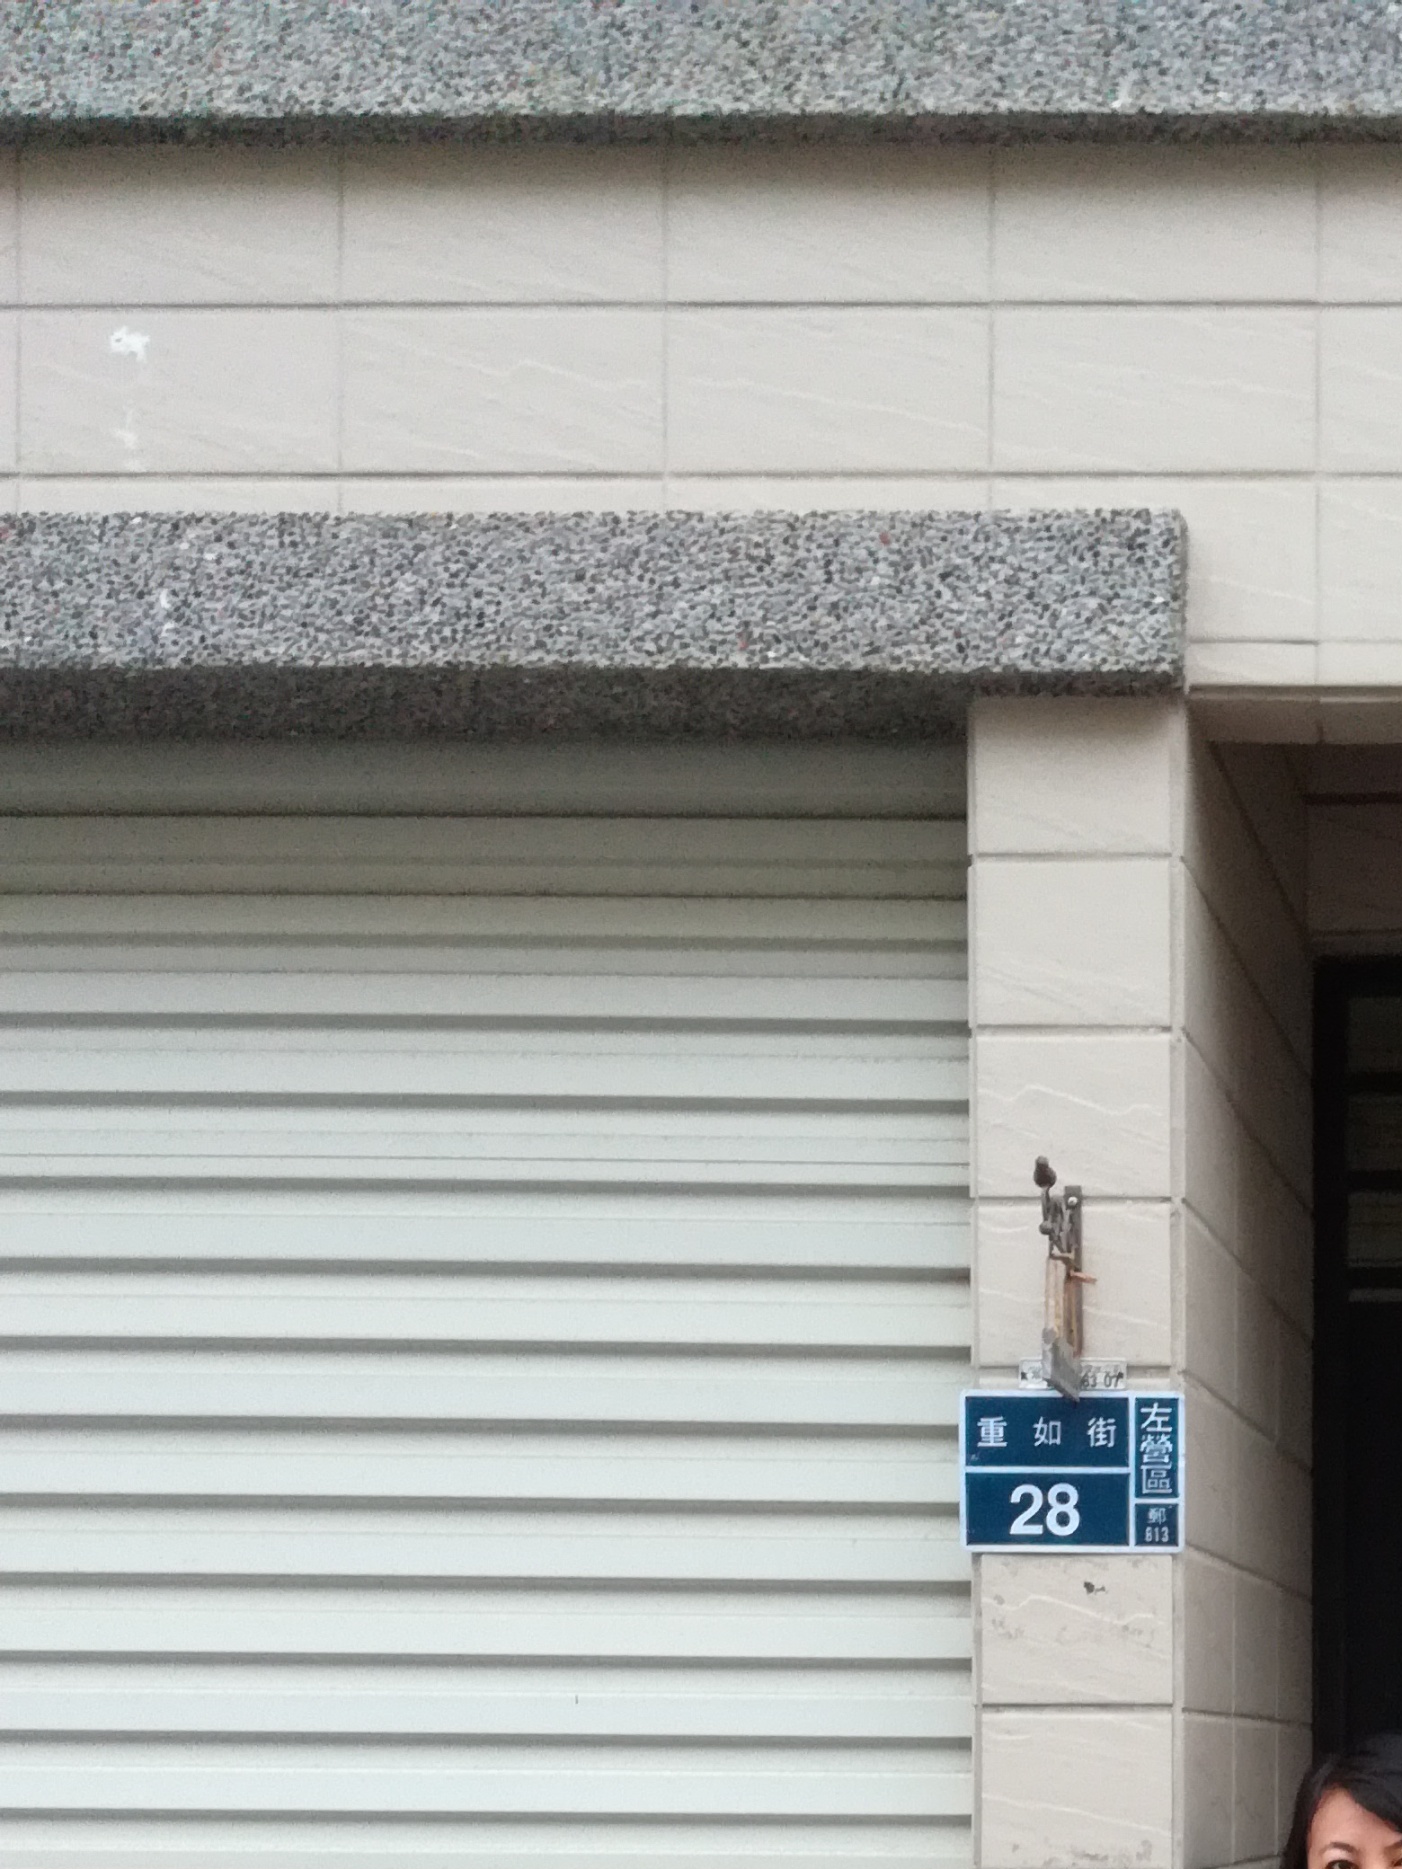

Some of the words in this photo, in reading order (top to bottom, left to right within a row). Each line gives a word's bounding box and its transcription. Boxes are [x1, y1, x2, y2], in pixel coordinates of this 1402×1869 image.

[976, 1416, 1117, 1448] 重如街
[1139, 1402, 1173, 1494] 左營區
[1009, 1482, 1080, 1536] 28
[1144, 1526, 1169, 1543] 813
